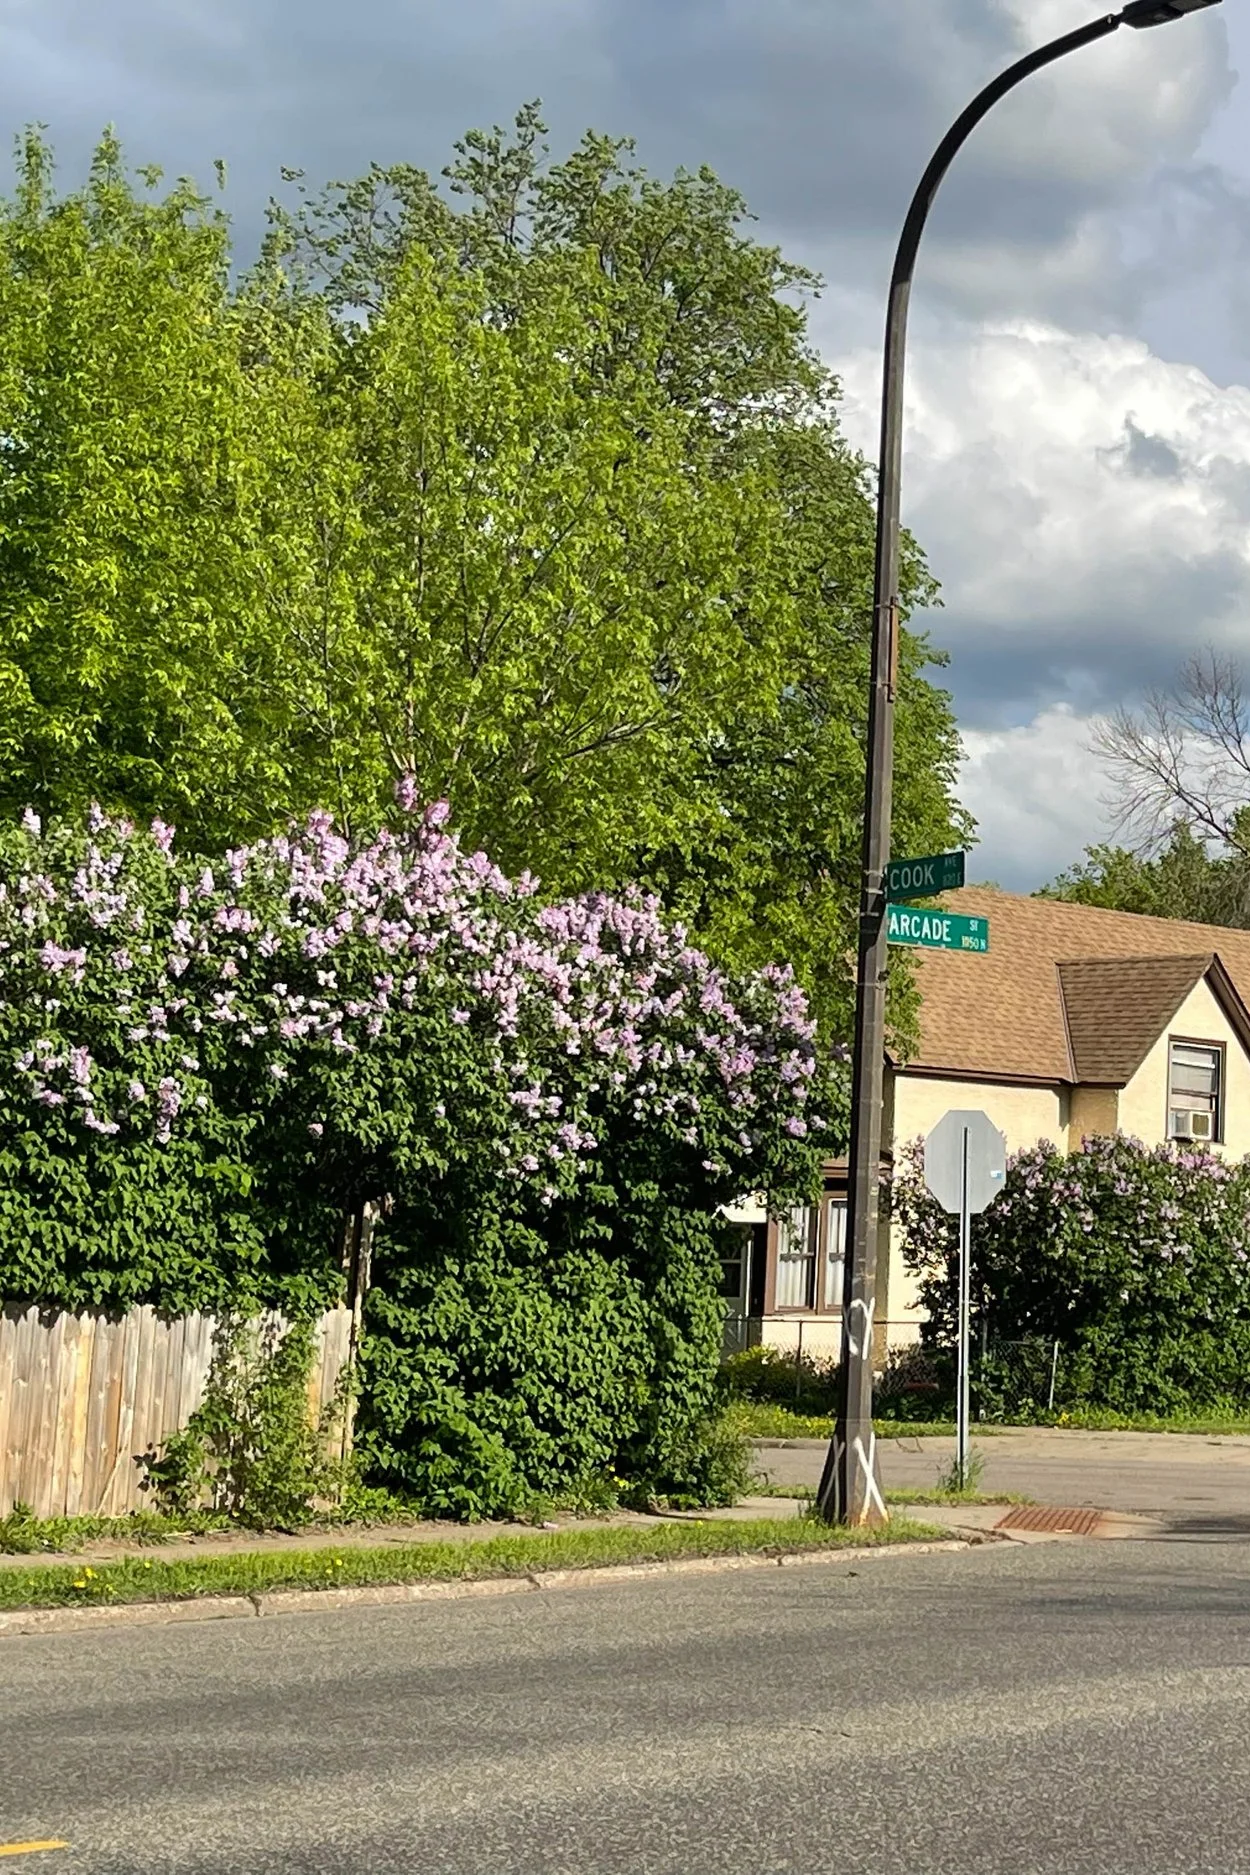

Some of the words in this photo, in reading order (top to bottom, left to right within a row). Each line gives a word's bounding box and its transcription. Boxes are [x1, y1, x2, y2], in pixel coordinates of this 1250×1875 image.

[889, 863, 935, 891] COOK
[888, 912, 952, 943] ARCADE
[969, 919, 979, 931] ST
